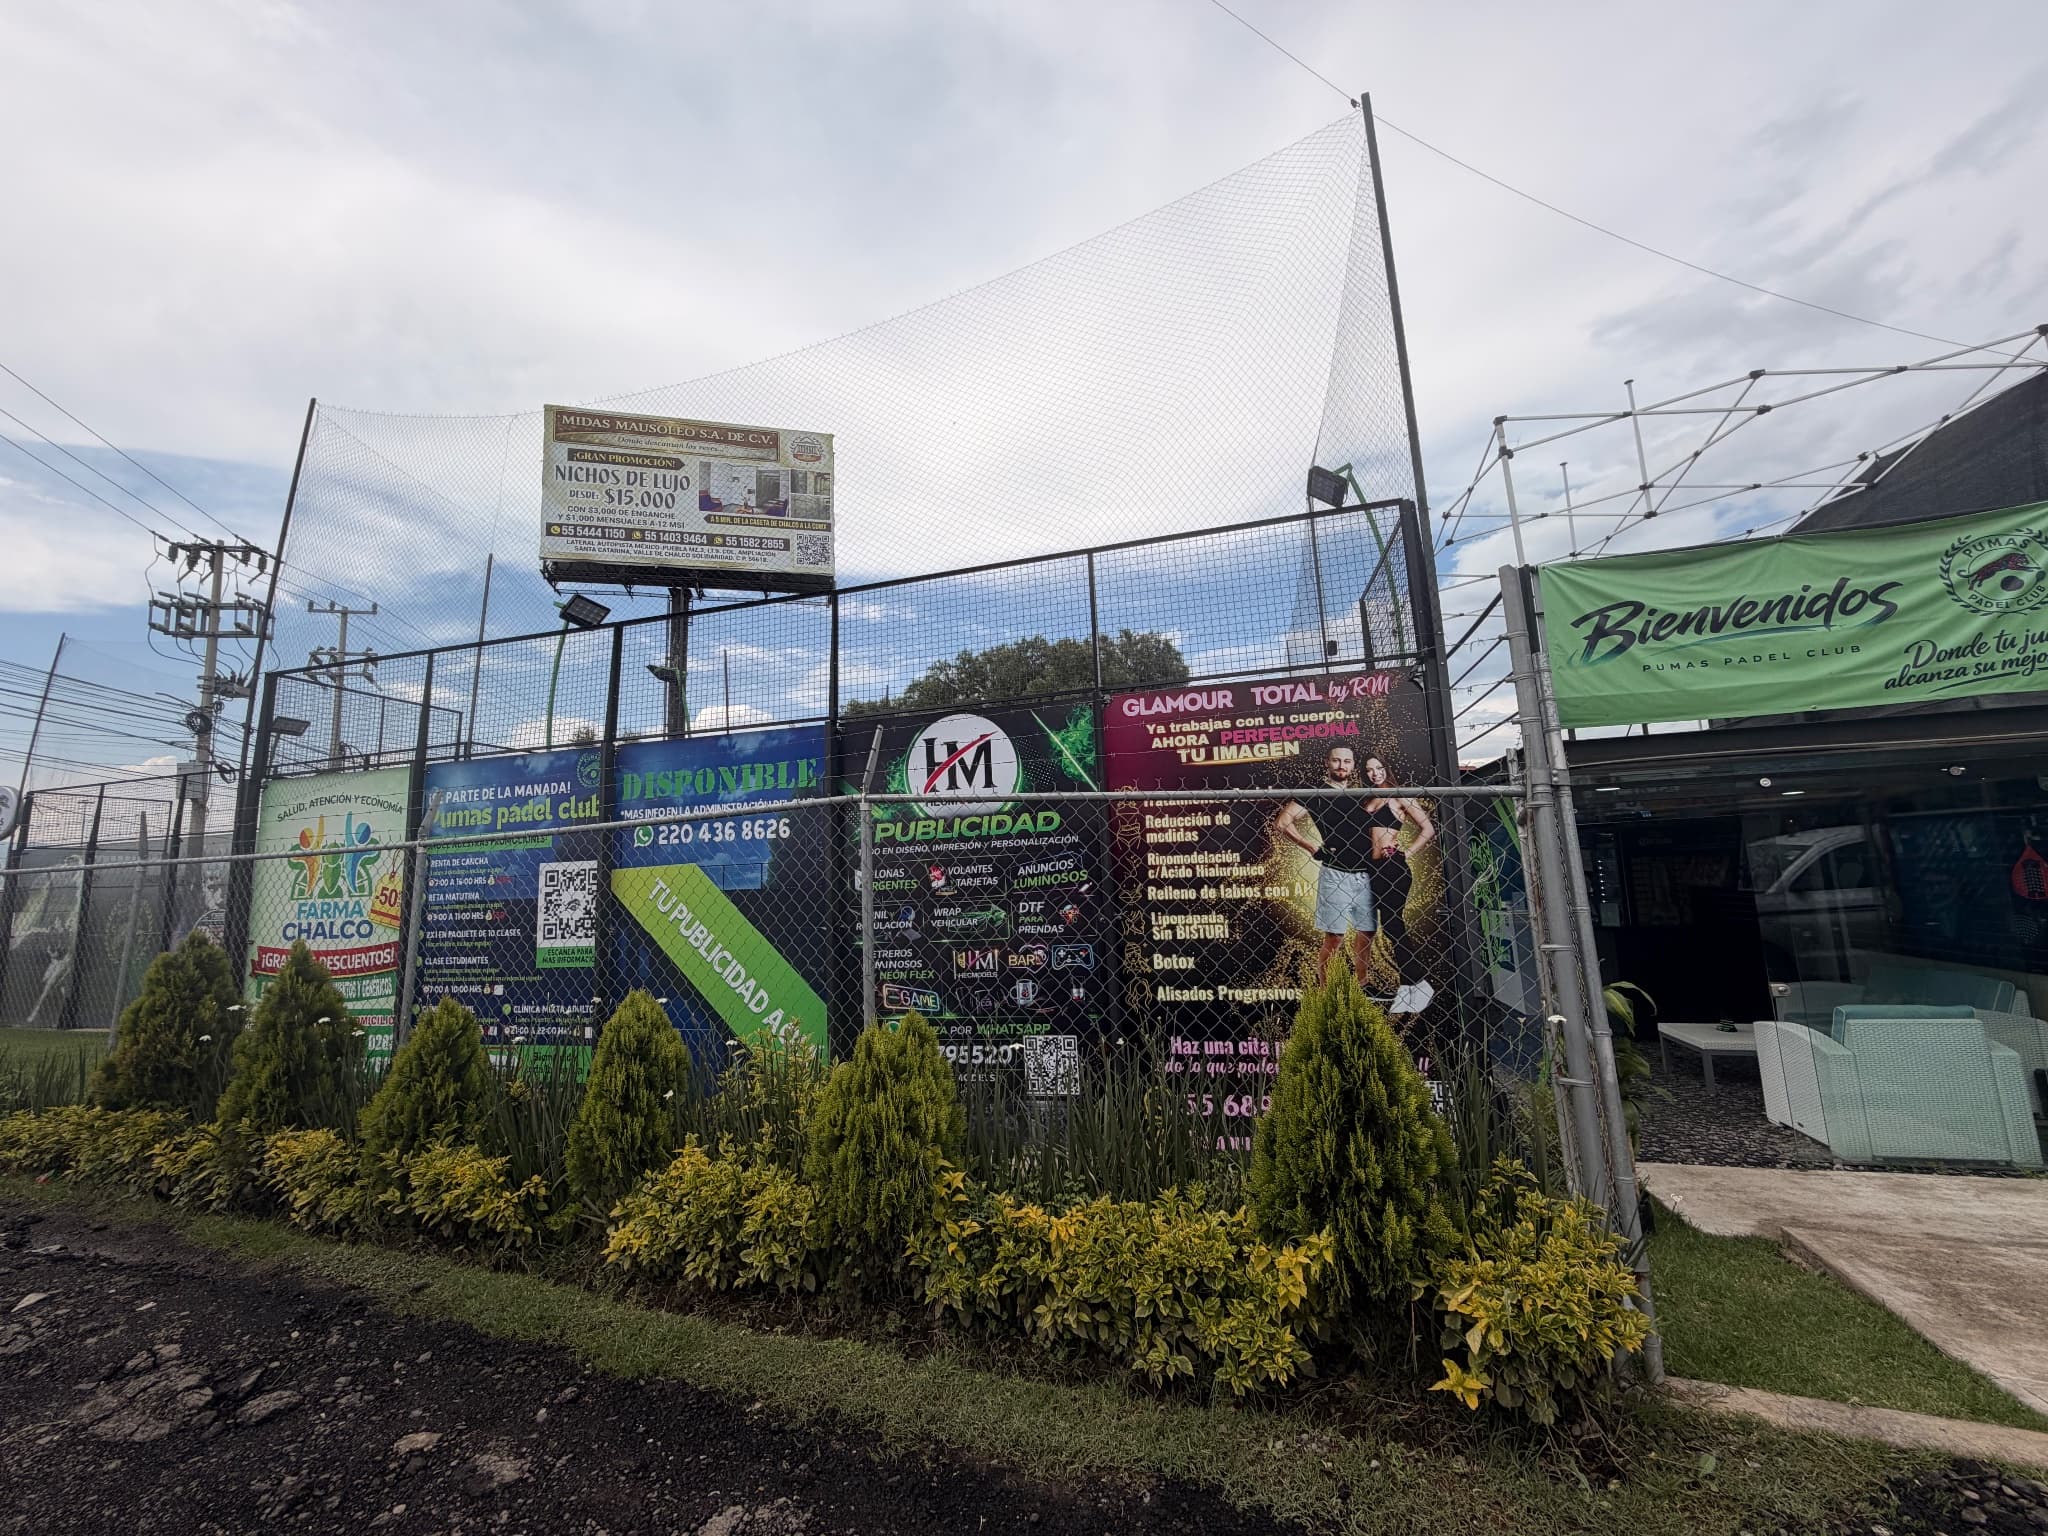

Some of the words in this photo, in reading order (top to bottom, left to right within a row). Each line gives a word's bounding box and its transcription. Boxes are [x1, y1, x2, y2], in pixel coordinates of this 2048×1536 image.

[562, 415, 610, 428] MIDAS
[615, 420, 695, 437] MAUSOLEO
[700, 430, 724, 440] S.A.
[727, 432, 745, 442] DE
[748, 433, 773, 445] C.V.
[608, 454, 676, 468] PROMOCIÓN!
[555, 465, 620, 485] NICHOS
[627, 470, 649, 488] DE
[654, 473, 690, 492] LUJO
[566, 514, 594, 522] $1,000
[596, 516, 648, 526] MENSUALES
[658, 520, 667, 528] 12
[567, 506, 586, 514] CON
[588, 507, 616, 516] $3,000
[631, 510, 676, 520] ENGANCHE
[749, 518, 770, 526] CASETA
[778, 520, 800, 528] CHALCO
[562, 525, 574, 536] 55
[576, 526, 602, 537] 5444
[604, 528, 626, 538] 1150
[644, 530, 656, 541] 55
[660, 532, 680, 542] 1403
[682, 534, 708, 544] 9464
[725, 536, 738, 546] 55
[740, 537, 760, 548] 1582
[762, 538, 784, 550] 2855
[597, 540, 633, 549] AUTOPISTA
[1962, 538, 2030, 558] PUMAS
[1968, 593, 2010, 608] PADEL
[2016, 585, 2047, 606] CLUB
[1570, 577, 1903, 667] Bienvenidos
[1642, 660, 1709, 673] PUMAS
[1724, 652, 1791, 666] PADEL
[1806, 645, 1862, 658] CLUB
[1904, 632, 1991, 669] Donde
[1993, 630, 2018, 653] tu
[1884, 664, 1970, 690] alcanza
[1974, 662, 1996, 676] su
[1122, 690, 1234, 718] GLAMOUR
[1250, 682, 1324, 706] TOTAL
[1328, 680, 1350, 702] by
[1146, 724, 1166, 735] Ya
[1168, 719, 1232, 734] trabajas
[1236, 717, 1264, 728] con
[1268, 714, 1284, 724] tu
[1288, 710, 1360, 726] cuerpo...
[1152, 735, 1210, 749] AHORA
[1220, 722, 1360, 745] PERFECCIONA
[1177, 748, 1206, 763] TU
[1212, 740, 1300, 762] IMAGEN
[622, 758, 818, 800] DISPONIBLE
[446, 788, 480, 804] PARTE
[482, 788, 495, 800] DE
[498, 785, 512, 799] LA
[514, 780, 571, 796] MANADA!
[277, 803, 308, 822] SALUD,
[308, 792, 352, 808] ATENCIÓN
[353, 795, 360, 804] Y
[361, 796, 403, 814] ECONOMÍA
[497, 797, 553, 830] pádel
[644, 806, 665, 818] INFO
[666, 806, 678, 818] EN
[875, 811, 1061, 842] PUBLICIDAD
[1146, 812, 1212, 829] Reducción
[1214, 812, 1231, 826] de
[658, 824, 693, 845] 220
[698, 820, 736, 843] 436
[741, 818, 791, 841] 8626
[1146, 828, 1200, 844] medidas
[882, 847, 894, 855] EN
[932, 840, 982, 852] IMPRESIÓN
[990, 834, 1078, 848] PERSONALIZACIÓN
[452, 858, 460, 866] DE
[462, 857, 489, 866] CANCHA
[1148, 850, 1240, 866] Rinomodelación
[874, 868, 905, 879] LONAS
[948, 864, 993, 876] VOLANTES
[1017, 858, 1074, 876] ANUNCIOS
[1196, 864, 1265, 878] Hialurónico
[474, 876, 487, 884] HRS
[872, 880, 918, 891] RGENTES
[956, 876, 998, 888] TARJETAS
[1013, 870, 1089, 889] LUMINOSOS
[1148, 886, 1196, 900] Relleno
[1200, 884, 1217, 900] de
[1220, 884, 1261, 899] labios
[1265, 886, 1290, 898] con
[296, 900, 364, 920] FARMA
[471, 911, 484, 920] HRS
[934, 907, 961, 917] WRAP
[1018, 902, 1046, 914] DTF
[1151, 910, 1225, 928] Lipopapada
[282, 919, 374, 942] CHALCO
[931, 918, 978, 927] VEHICULAR
[1018, 916, 1044, 924] PARA
[1018, 924, 1065, 934] PRENDAS
[1153, 928, 1172, 940] Sin
[1176, 920, 1230, 940] BISTURÍ
[438, 930, 447, 938] EN
[448, 929, 478, 938] PAQUETE
[478, 928, 486, 936] DE
[496, 928, 520, 937] CLASES
[649, 877, 678, 914] TU
[668, 902, 770, 1014] PUBLICIDAD
[424, 957, 444, 966] CLASE
[446, 956, 488, 966] ESTUDIANTES
[1154, 953, 1196, 970] Botox
[909, 970, 935, 980] FLEX
[1157, 986, 1215, 1001] Alisados
[1218, 985, 1302, 1004] Progresivos
[950, 1026, 973, 1036] POR
[976, 1023, 1052, 1035] WHATSAPP
[1170, 1036, 1200, 1055] Haz
[1204, 1041, 1234, 1054] una
[1238, 1037, 1270, 1055] cita
[1206, 1062, 1234, 1078] que
